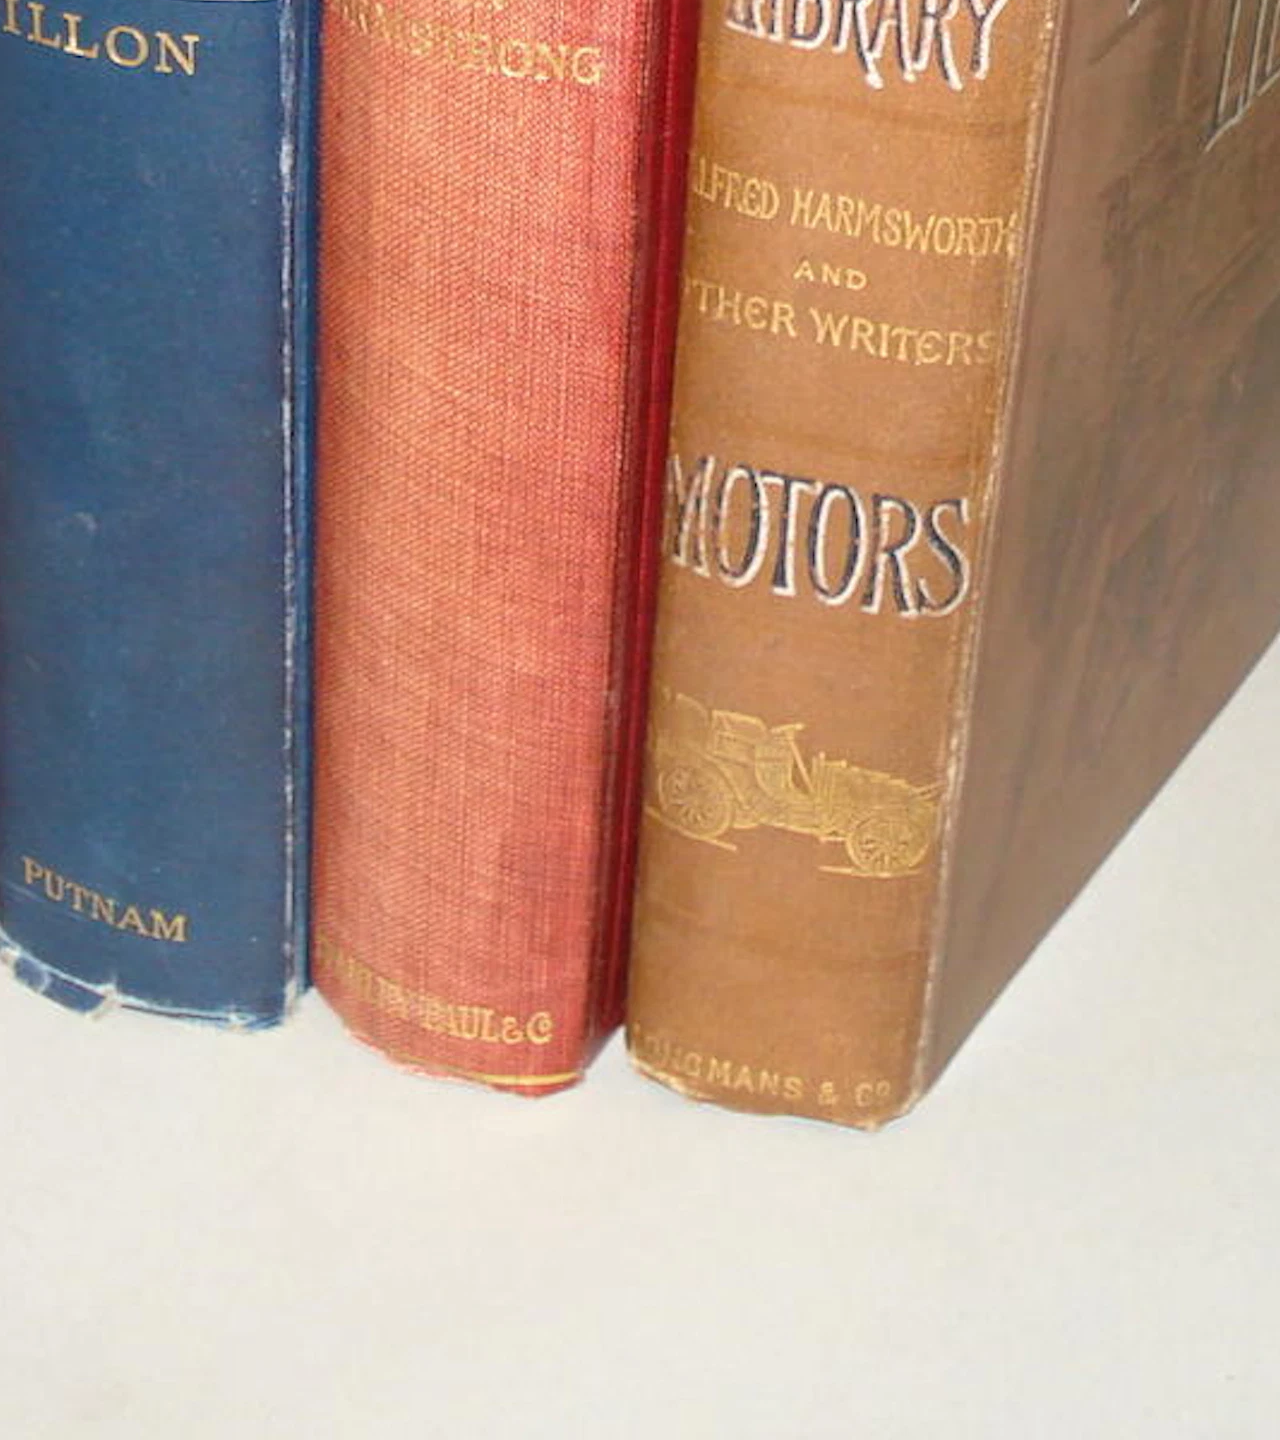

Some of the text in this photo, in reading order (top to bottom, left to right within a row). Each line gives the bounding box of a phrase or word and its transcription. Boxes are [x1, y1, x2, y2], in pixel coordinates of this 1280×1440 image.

[690, 157, 1020, 258] LFRED HARMSWORTH
[793, 259, 869, 291] AND
[684, 277, 997, 366] THER WRITERS
[663, 453, 971, 619] MOTORS
[23, 857, 188, 943] PUTNAM
[818, 1081, 840, 1106] &
